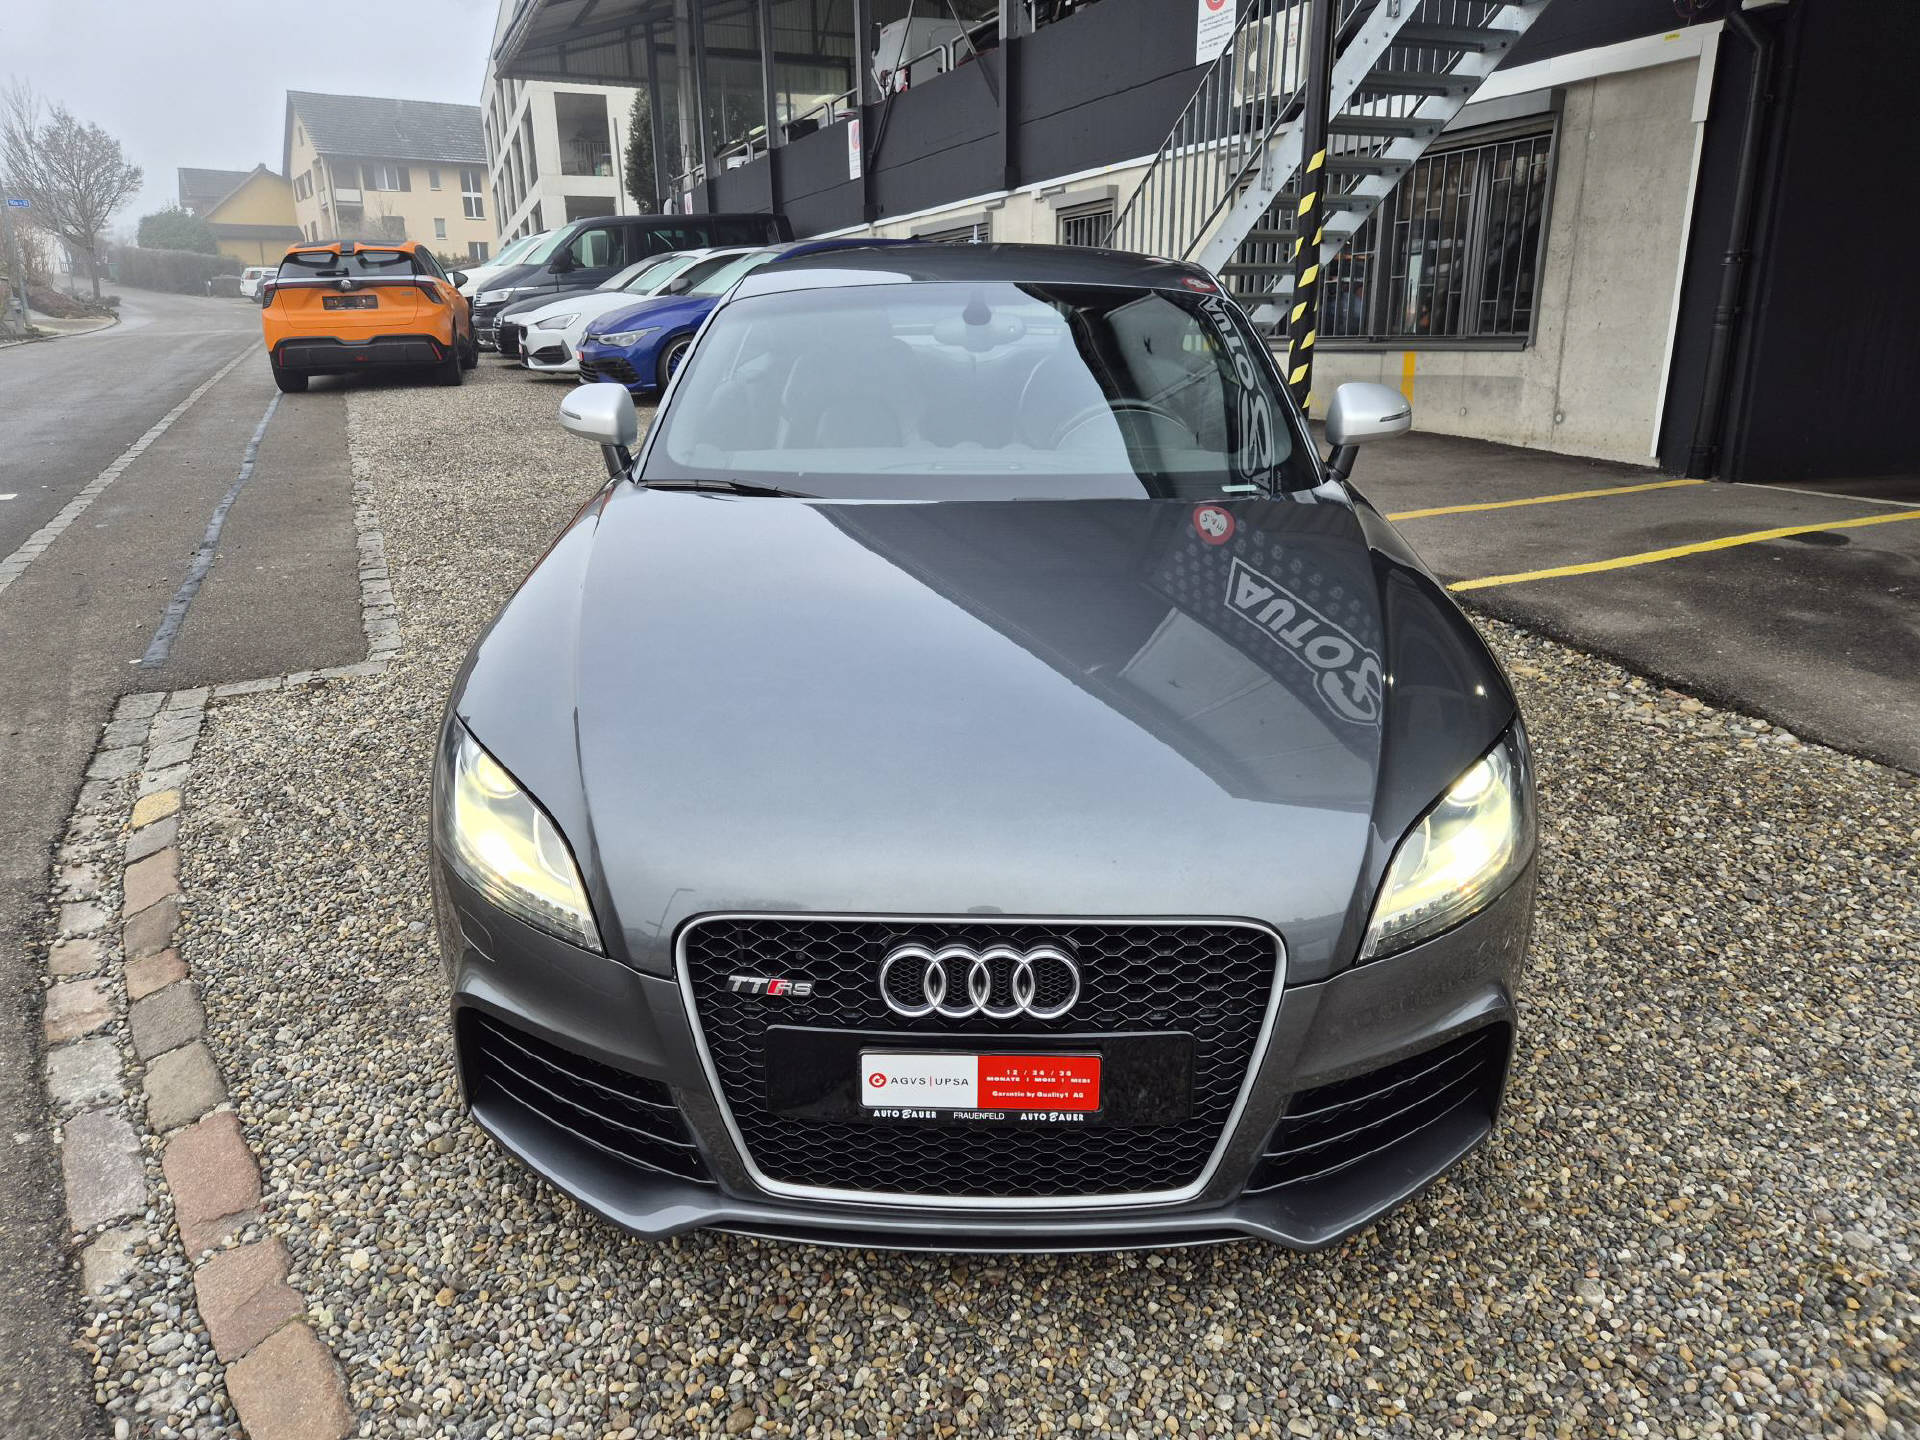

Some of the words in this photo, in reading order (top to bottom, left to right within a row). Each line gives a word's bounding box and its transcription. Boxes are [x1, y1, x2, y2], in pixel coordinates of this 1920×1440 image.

[935, 1078, 969, 1086] UPSA
[873, 1109, 900, 1118] AUTO
[901, 1109, 937, 1119] BAUER
[953, 1111, 1005, 1120] FRAUENFELD
[1020, 1112, 1047, 1121] AUTO
[1048, 1111, 1084, 1122] BAUER
